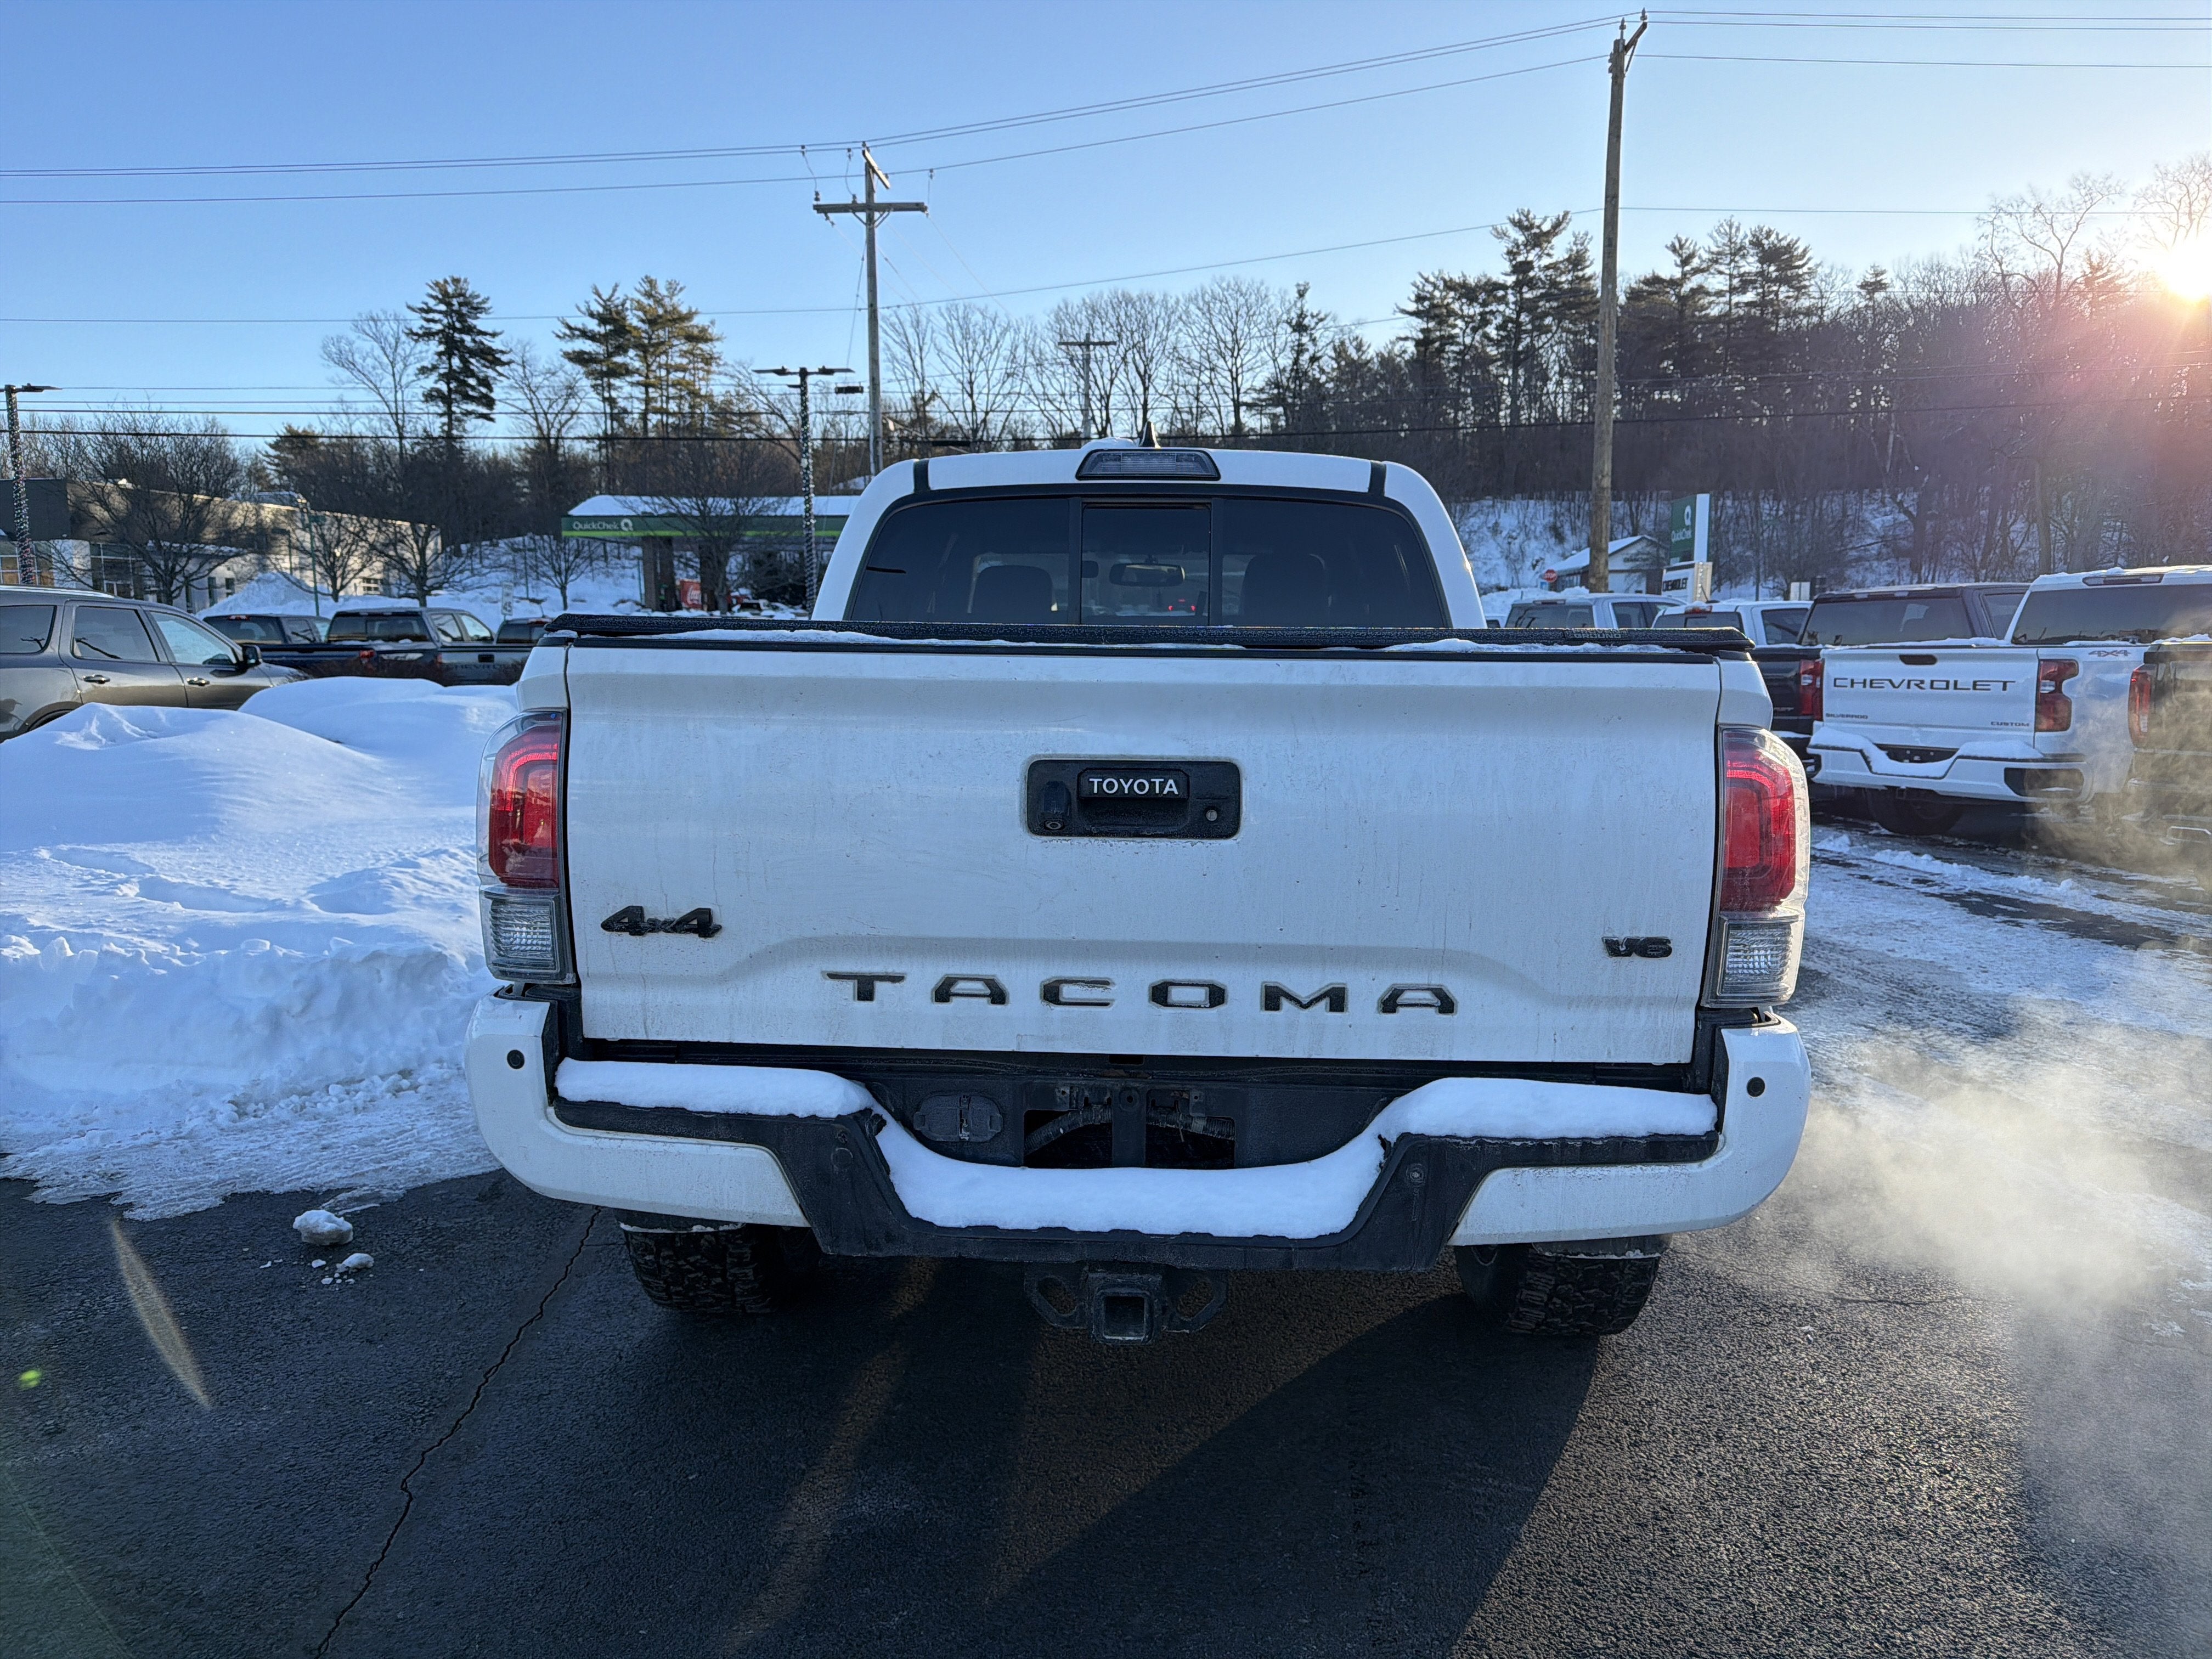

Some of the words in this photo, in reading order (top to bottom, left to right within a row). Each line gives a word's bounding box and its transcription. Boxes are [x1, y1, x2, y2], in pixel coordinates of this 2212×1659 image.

[1833, 678, 2016, 691] CHEVROLET
[1089, 778, 1178, 795] TOYOTA
[1601, 936, 1672, 958] V6
[825, 972, 1457, 1015] TACOMA
